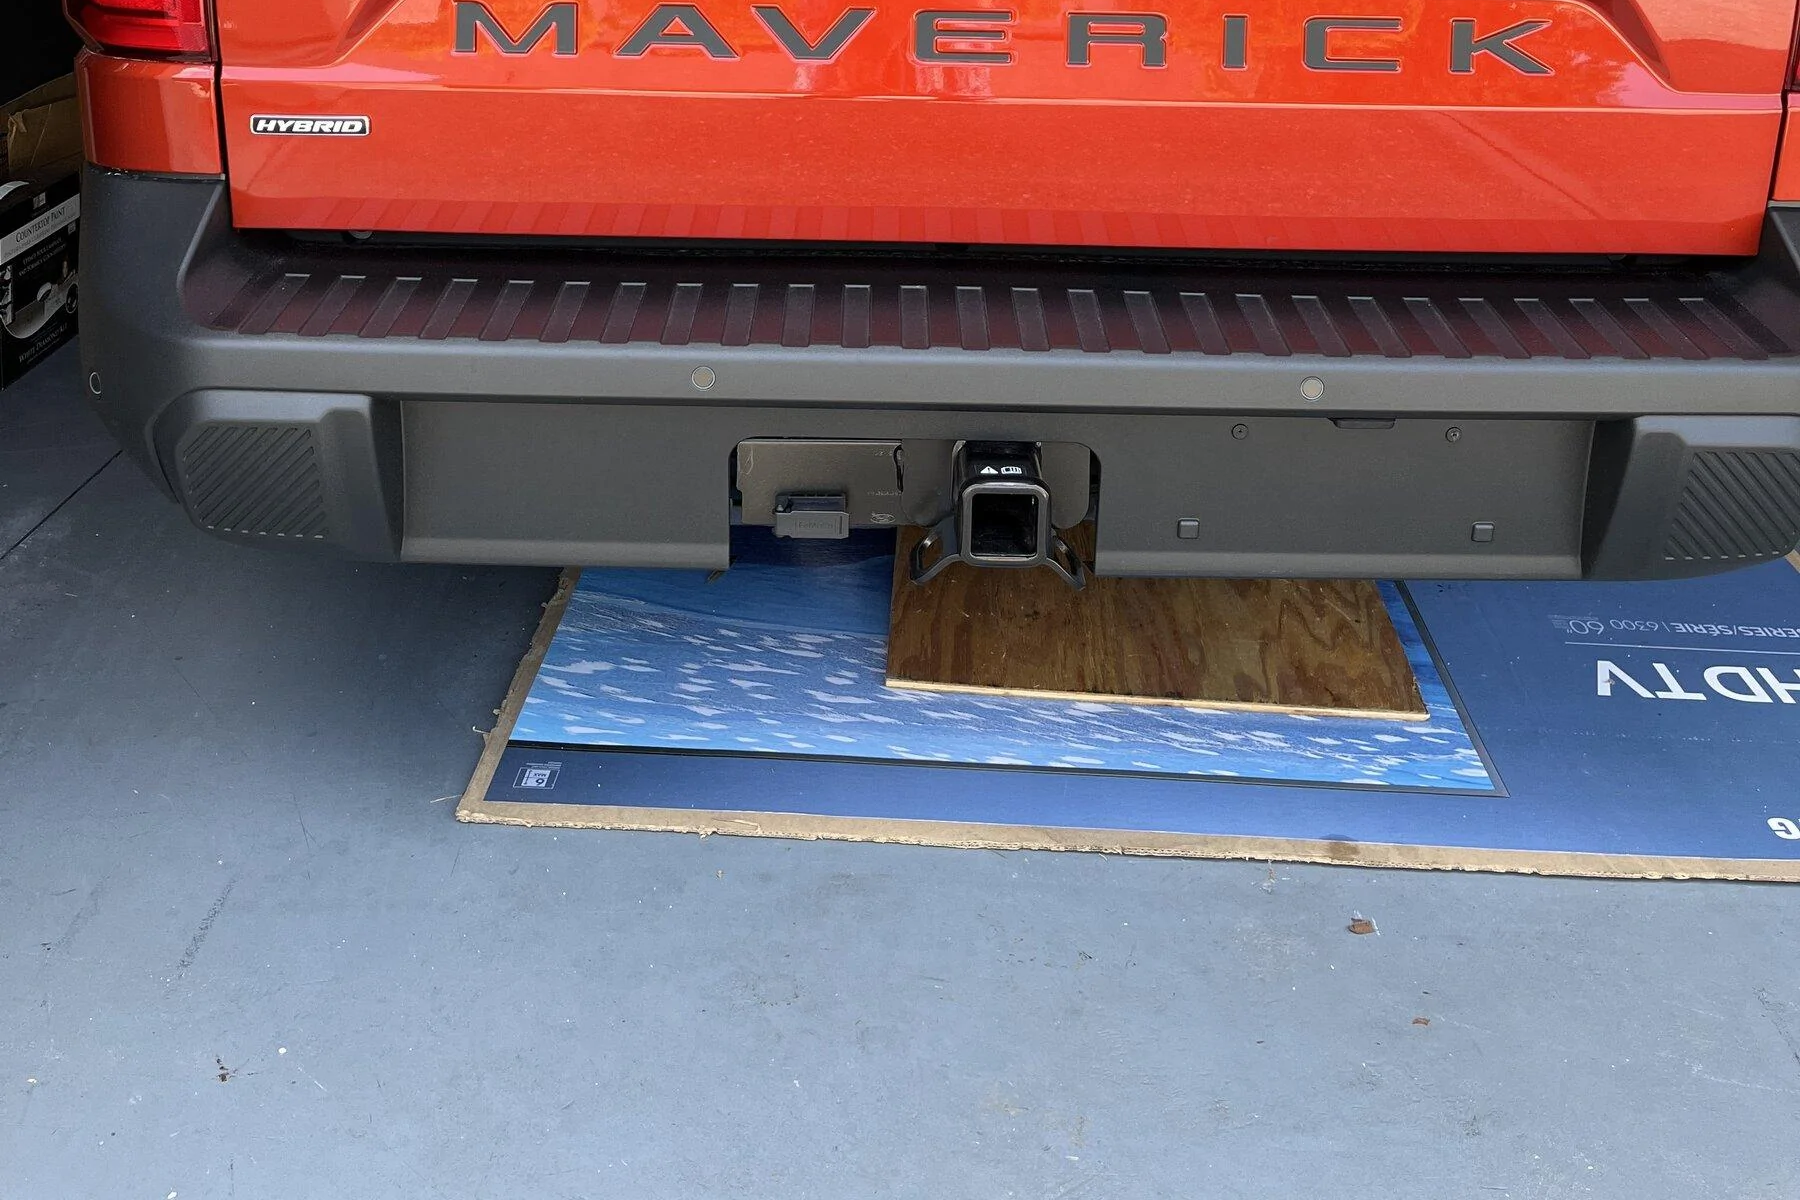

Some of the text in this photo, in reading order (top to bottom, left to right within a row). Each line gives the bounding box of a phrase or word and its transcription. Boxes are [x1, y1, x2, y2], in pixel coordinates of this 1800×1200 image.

[451, 0, 1556, 77] MAVERICK
[257, 119, 362, 132] HYBRID
[1609, 618, 1659, 632] 6300
[1597, 660, 1800, 704] HDTV
